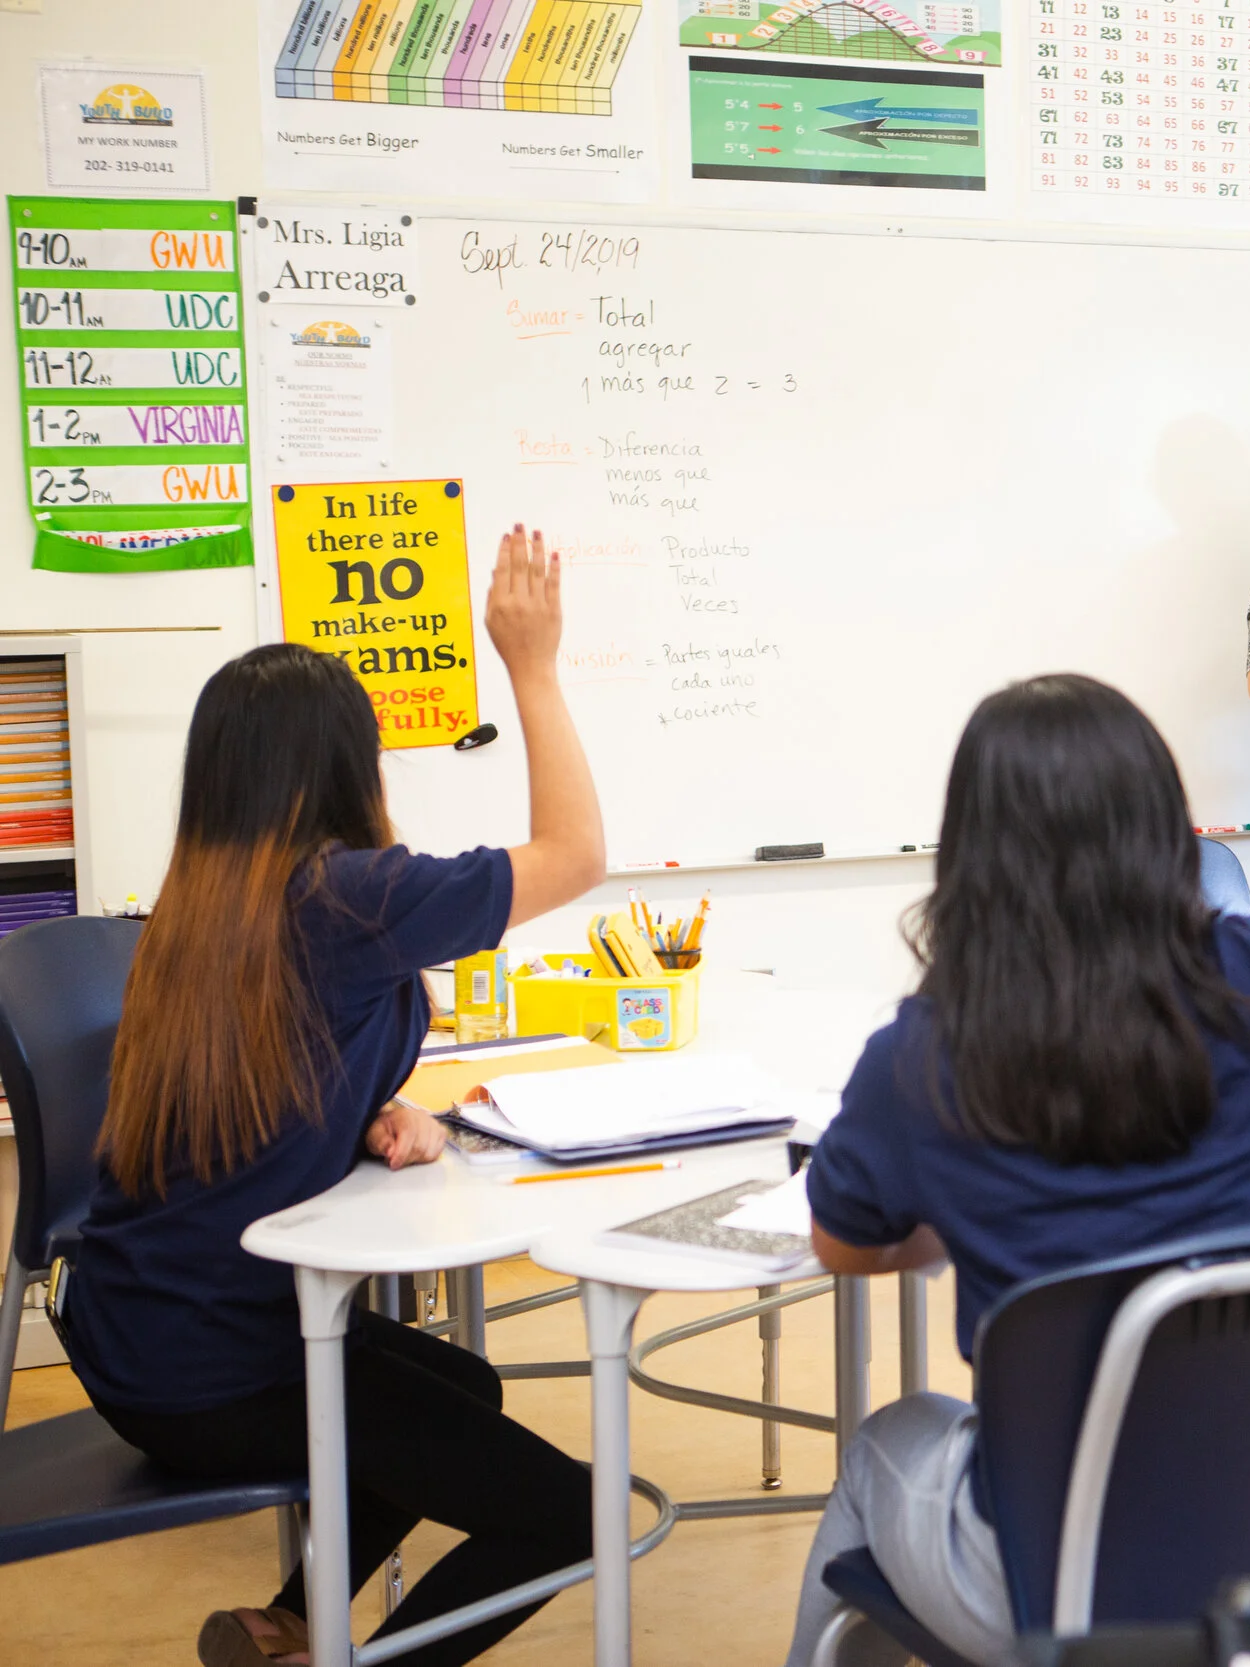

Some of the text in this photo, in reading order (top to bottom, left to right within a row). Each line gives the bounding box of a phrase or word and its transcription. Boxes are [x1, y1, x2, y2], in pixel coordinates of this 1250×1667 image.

[882, 10, 897, 18] 6
[442, 20, 460, 55] thousands
[460, 23, 477, 55] hundreds
[482, 32, 492, 48] tens
[501, 33, 511, 49] ones
[523, 32, 536, 53] tenths
[537, 25, 557, 63] hundredths
[555, 24, 576, 65] thousandths
[1100, 27, 1122, 41] 23
[923, 44, 938, 52] 8
[965, 51, 976, 60] 9
[1217, 57, 1238, 71] 37
[1100, 70, 1238, 93] 43 47
[793, 103, 803, 113] 5
[1101, 91, 1124, 105] 53
[796, 125, 805, 135] 6
[1218, 120, 1238, 134] 67
[78, 136, 178, 148] MY WORK NUMBER
[277, 131, 419, 152] Numbers Get Bigger
[502, 143, 644, 161] Numbers Get Smaller
[1103, 134, 1123, 148] 73
[85, 160, 174, 173] 202- 319-0141
[1103, 155, 1123, 169] 83
[1041, 175, 1056, 186] 91
[1218, 183, 1239, 197] 97
[273, 219, 404, 253] Mrs. Ligia
[151, 230, 227, 269] GWU
[275, 260, 407, 299] Arreaga
[165, 293, 234, 329] UDC
[506, 299, 569, 328] Sumar
[590, 296, 654, 327] Total
[600, 340, 692, 368] agregar
[172, 351, 237, 387] UDC
[602, 371, 645, 393] más
[658, 378, 696, 401] que
[714, 376, 728, 395] 2
[783, 374, 798, 393] 3
[128, 406, 244, 444] VIRGINIA
[598, 431, 704, 459] Diferencia
[162, 465, 239, 503] GWU
[606, 467, 714, 491] menos que
[324, 492, 418, 520] In life
[610, 485, 700, 517] más que
[306, 529, 438, 553] there are
[660, 535, 750, 560] Producto
[327, 556, 425, 606] no
[669, 564, 718, 587] Total
[680, 593, 739, 615] Veces
[312, 613, 447, 638] make-up
[337, 641, 467, 675] ams.
[662, 643, 711, 666] Partes
[715, 639, 781, 669] iguales
[671, 673, 754, 690] cada uno
[370, 686, 445, 706] oose
[377, 706, 468, 732] fully.
[673, 700, 761, 721] cociente
